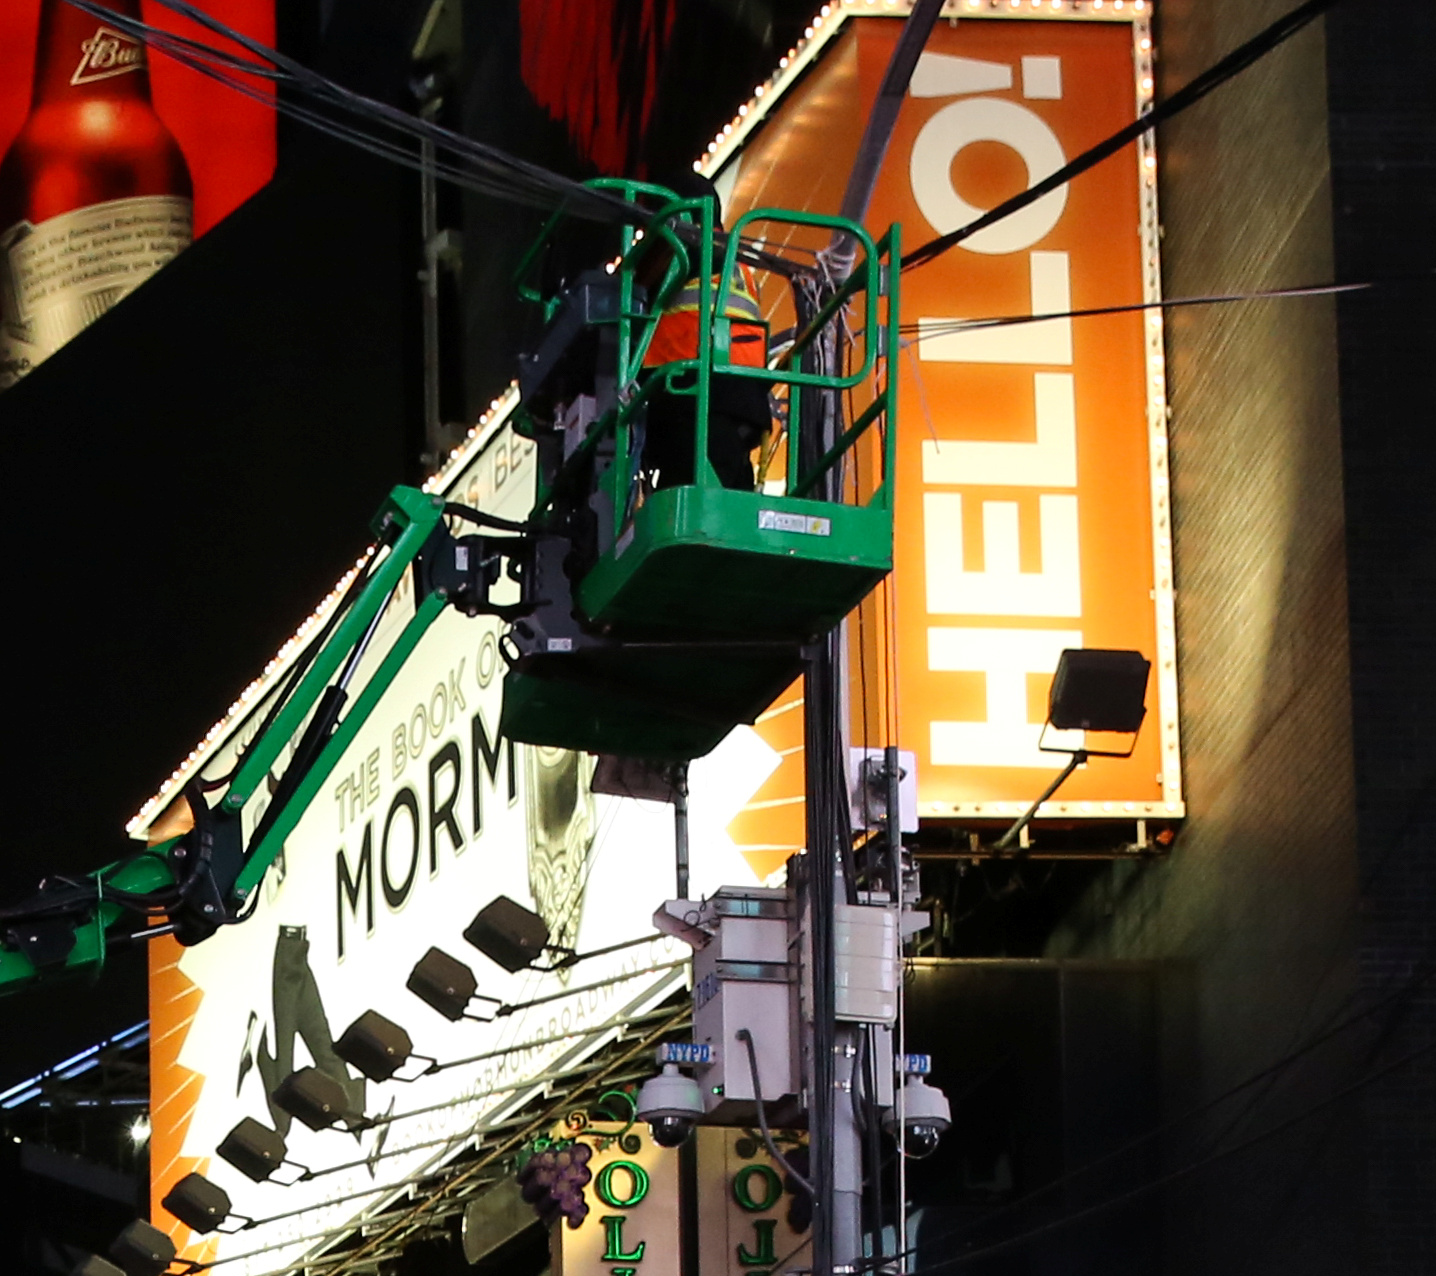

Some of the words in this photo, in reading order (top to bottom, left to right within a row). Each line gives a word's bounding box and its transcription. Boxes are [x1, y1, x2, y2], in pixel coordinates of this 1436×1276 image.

[910, 50, 1088, 770] HELLO!
[334, 747, 381, 833] THE
[392, 656, 467, 782] BOOK
[477, 629, 507, 690] O
[336, 711, 520, 966] MORM
[666, 1044, 710, 1062] NYPD
